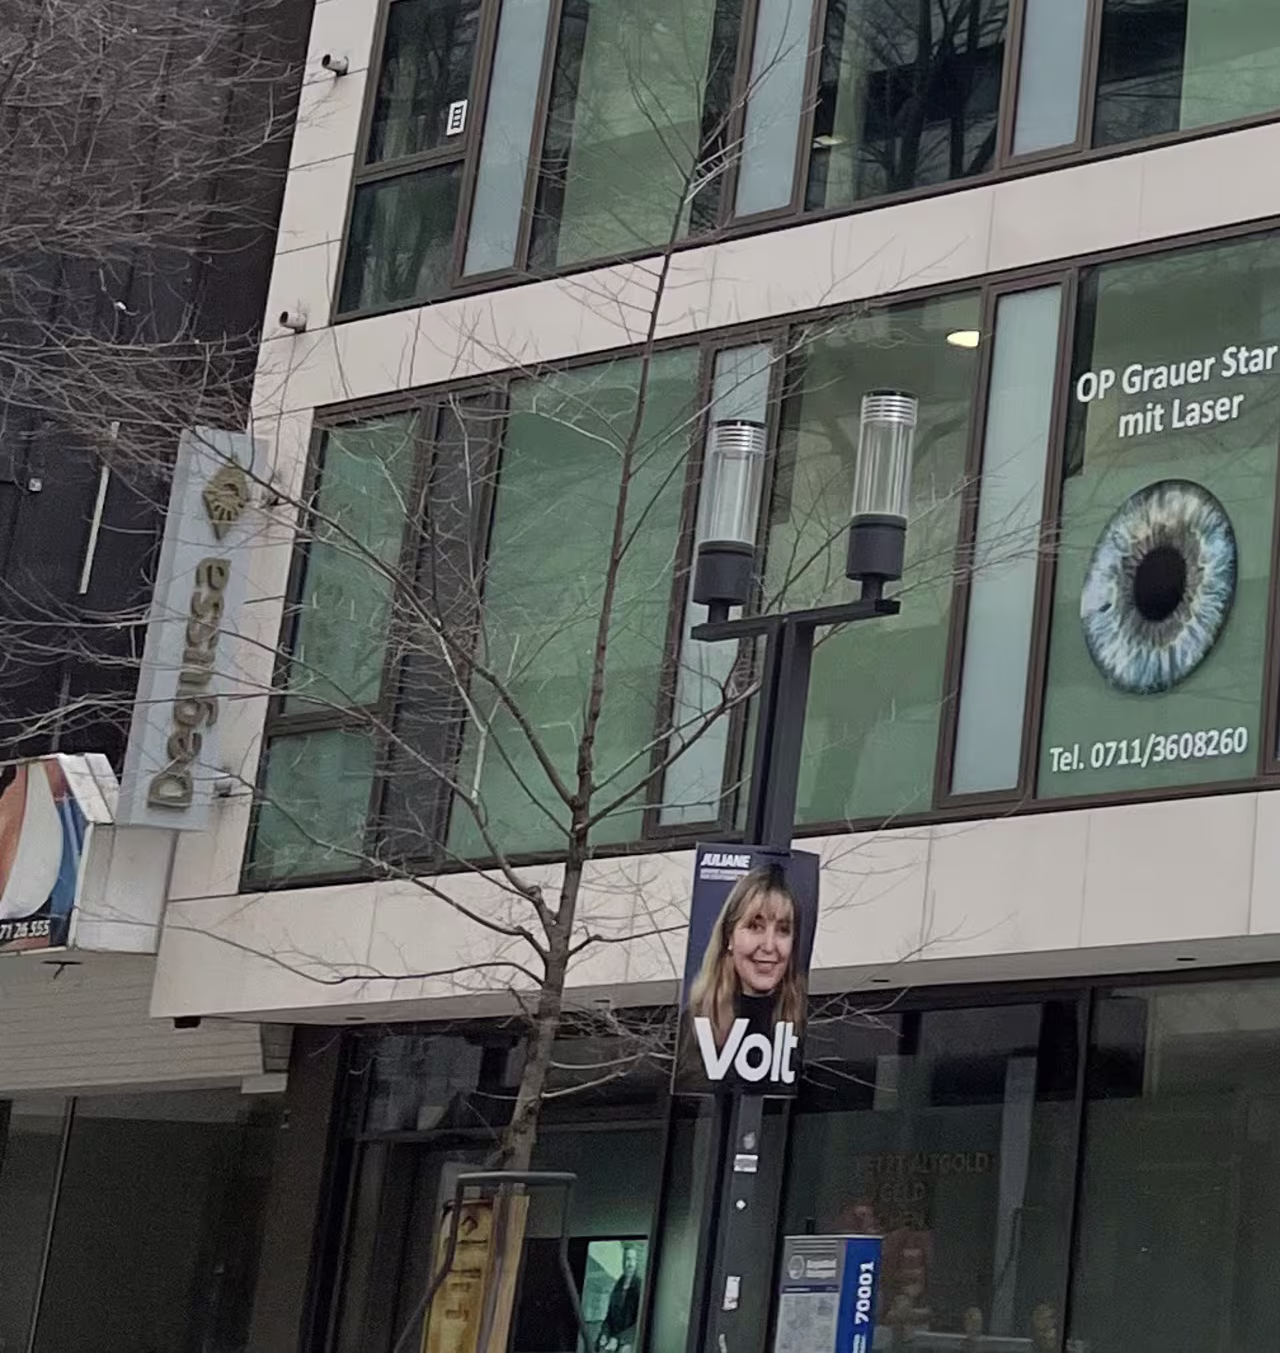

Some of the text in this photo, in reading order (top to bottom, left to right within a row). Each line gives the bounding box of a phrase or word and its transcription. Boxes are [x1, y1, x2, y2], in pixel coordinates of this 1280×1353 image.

[1076, 345, 1279, 402] OP Grauer Star
[1119, 394, 1244, 437] mit Laser
[1049, 727, 1248, 772] Tel. 0711/3608260
[701, 852, 751, 869] JULIANE
[694, 1017, 799, 1084] Volt
[854, 1261, 875, 1325] 70001
